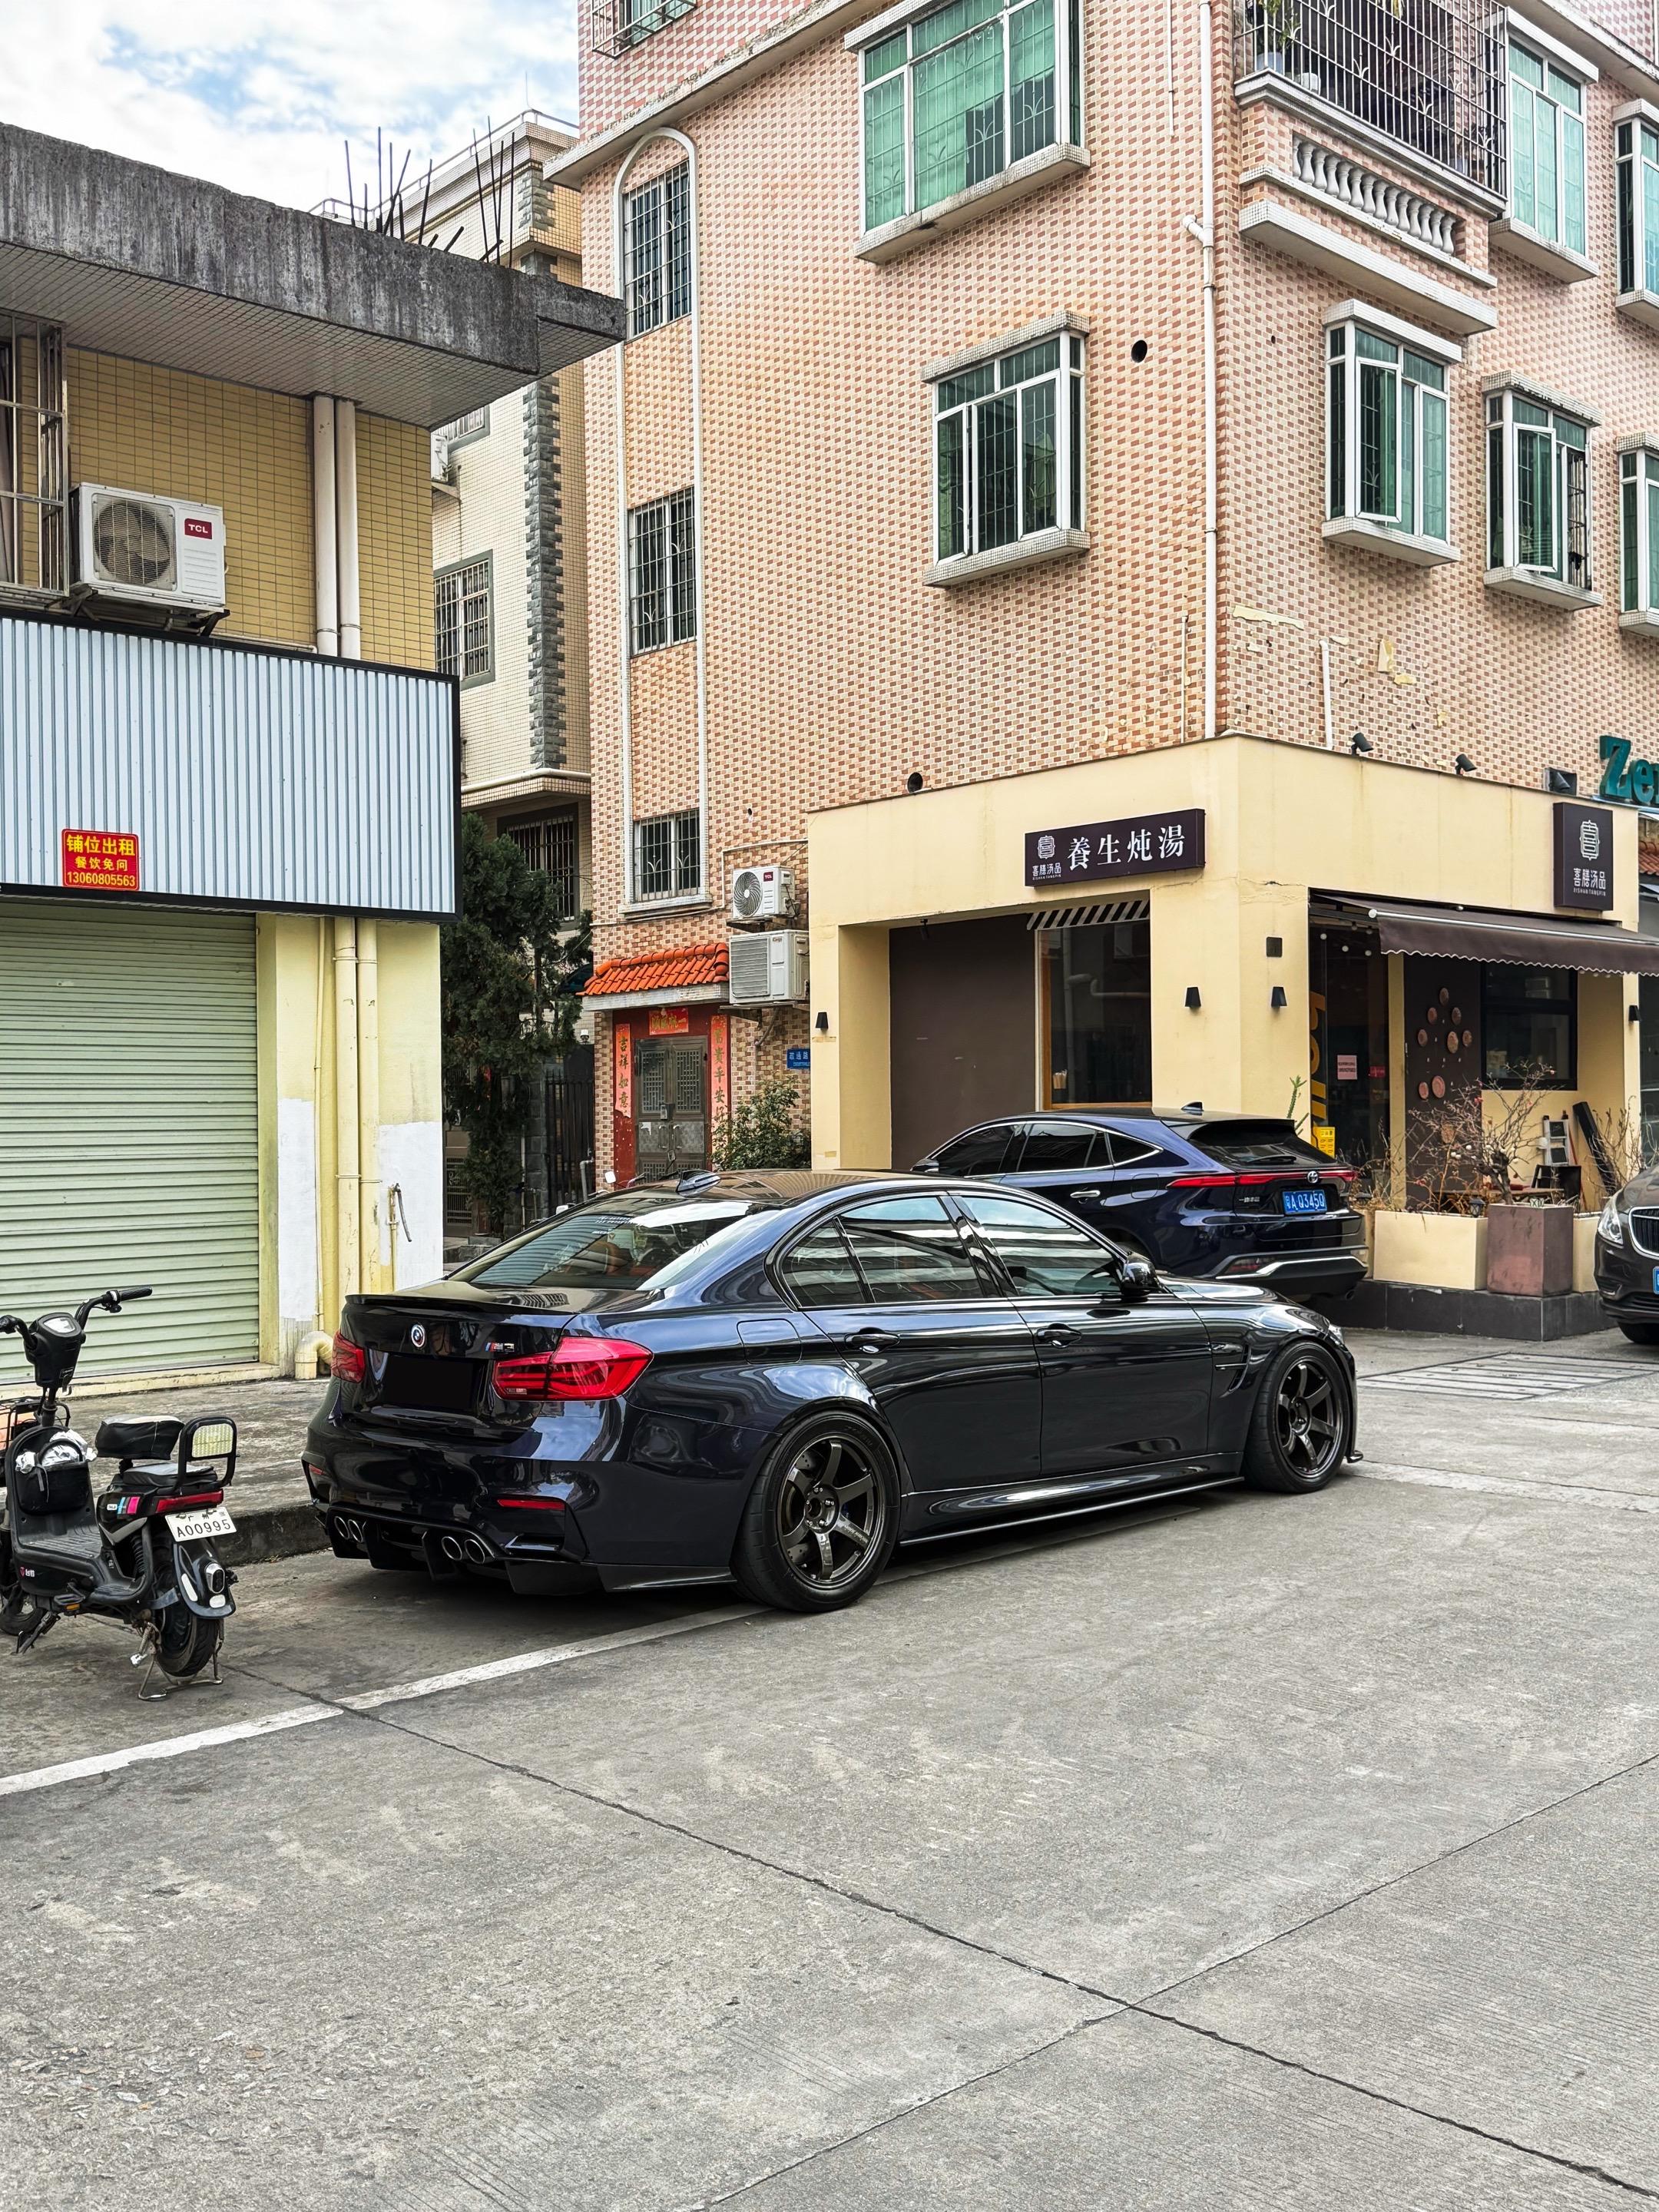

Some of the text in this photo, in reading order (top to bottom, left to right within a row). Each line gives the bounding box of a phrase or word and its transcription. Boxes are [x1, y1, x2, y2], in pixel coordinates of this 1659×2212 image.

[188, 523, 208, 534] TCL
[66, 834, 135, 856] 铺位出租
[1067, 824, 1185, 871] 養生炖湯
[75, 856, 128, 872] 餐饮免问
[67, 871, 136, 887] 13060805563
[618, 1035, 629, 1114] 吉祥如意
[177, 1518, 231, 1538] A00995
